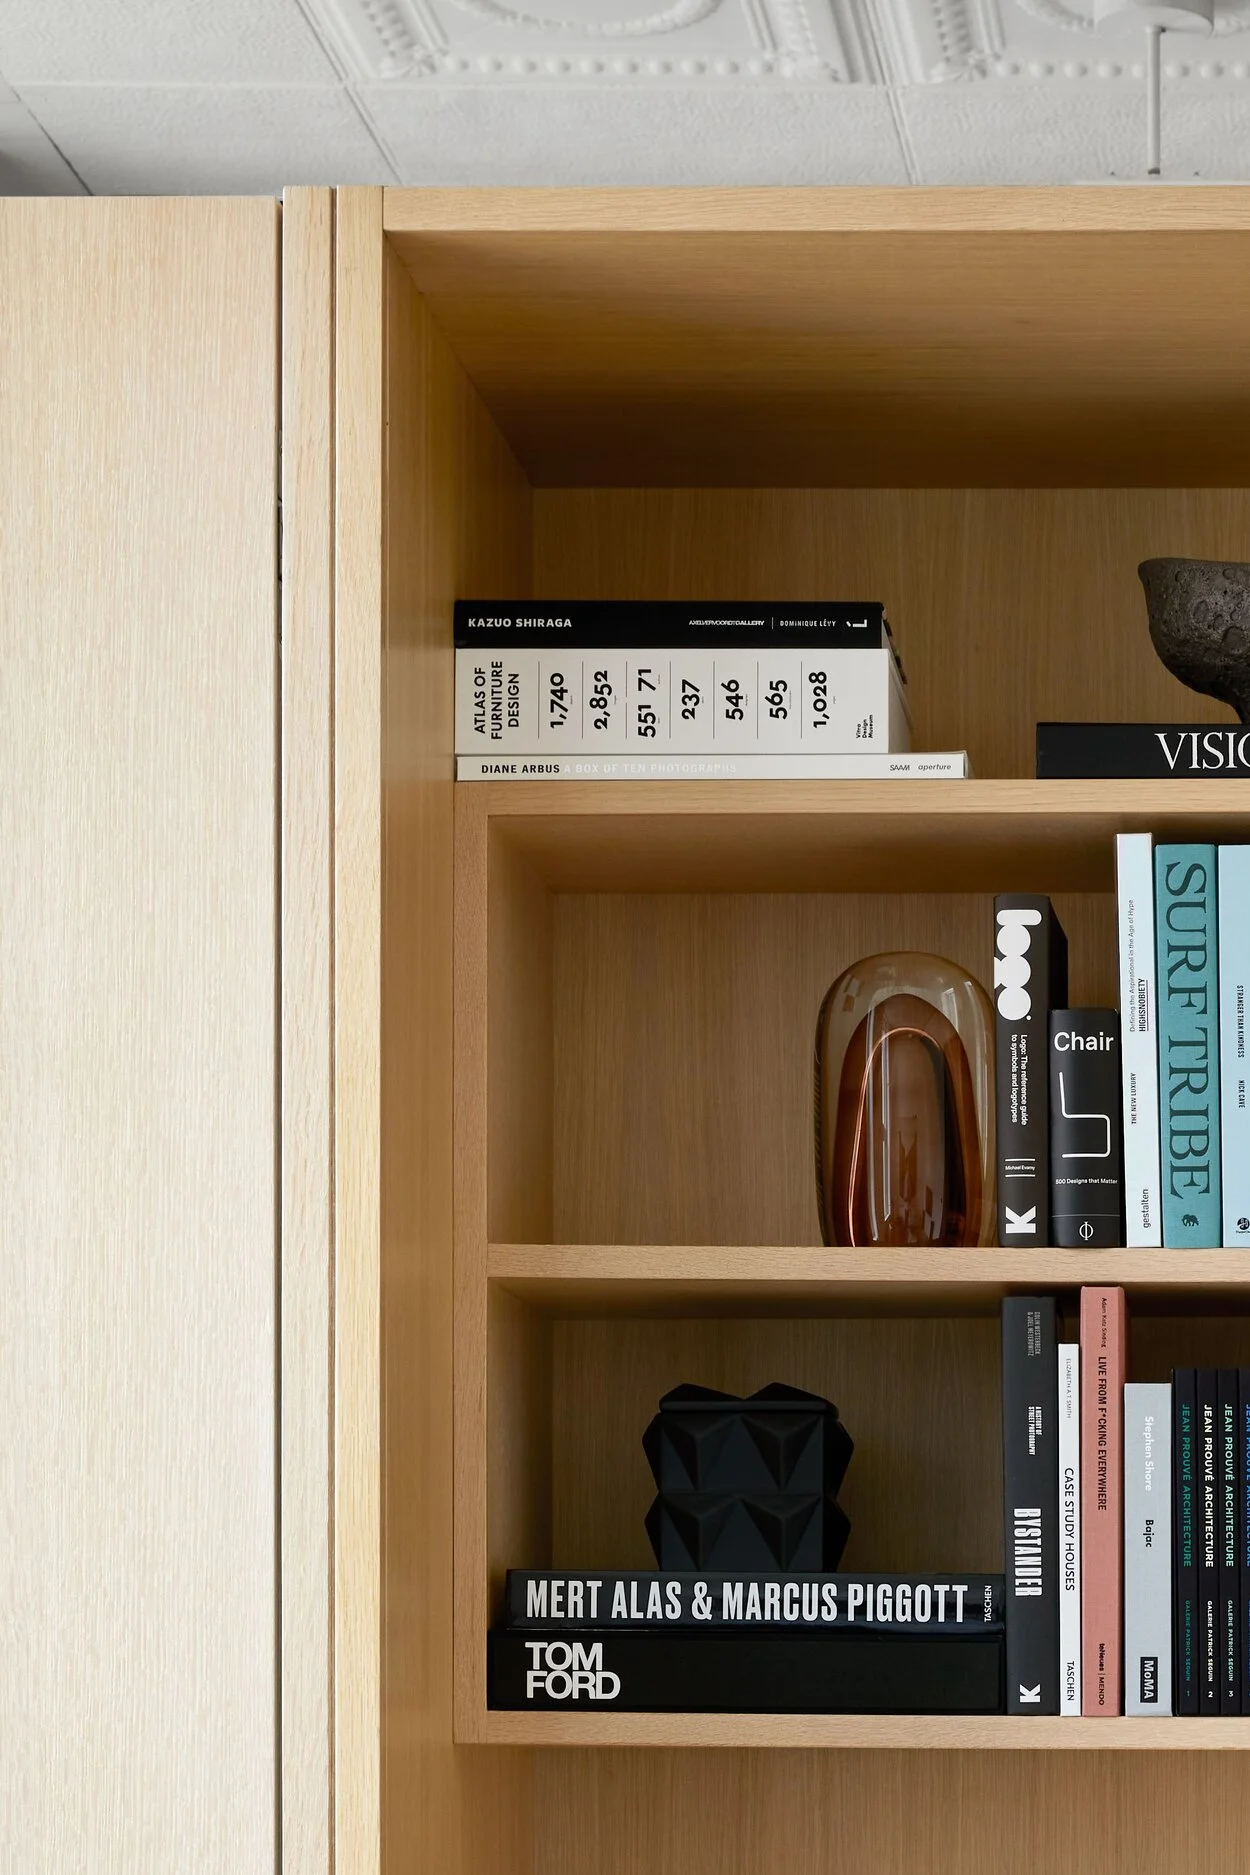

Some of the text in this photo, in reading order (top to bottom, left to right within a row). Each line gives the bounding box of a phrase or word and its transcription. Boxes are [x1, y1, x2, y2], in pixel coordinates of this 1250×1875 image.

[468, 618, 572, 628] KAZUO SHIRAGA
[638, 669, 656, 691] 71
[682, 679, 700, 719] 237
[765, 680, 787, 719] 565
[473, 667, 486, 735] ATLAS OF
[490, 661, 503, 740] FURNITURE
[507, 673, 520, 728] DESIGN
[550, 673, 568, 728] 1,740
[590, 671, 612, 729] 2,852
[721, 680, 743, 720] 546
[809, 672, 829, 728] 1,028
[638, 705, 656, 737] 551
[481, 764, 560, 774] DIANE ARBUS
[917, 763, 952, 772] aperture
[1137, 978, 1146, 1033] HIGHSNOBIETY
[1019, 1034, 1028, 1054] Logo:
[1054, 1032, 1113, 1051] Chair
[1165, 862, 1211, 1200] SURF TRIBE
[1020, 1055, 1029, 1070] The
[1237, 1079, 1246, 1109] NICK CAVE
[1006, 1206, 1036, 1233] K
[1140, 1188, 1152, 1229] gestalten
[1098, 1356, 1107, 1377] LIVE
[1098, 1378, 1107, 1405] FROM
[1142, 1416, 1155, 1492] Stephen Shore
[1098, 1449, 1107, 1511] EVERYWHERE
[1203, 1404, 1215, 1568] JEAN PROUVÉ ARCHITECTURE
[1224, 1403, 1235, 1567] JEAN PROUVÉ ARCHITECTURE
[1064, 1467, 1075, 1591] CASE STUDY HOUSES
[1142, 1519, 1155, 1548] Bajac
[1014, 1509, 1042, 1596] BYSTANDER
[527, 1580, 968, 1622] MERT ALAS & MARCUS PIGGOTT
[983, 1585, 992, 1623] TASCHEN
[525, 1641, 604, 1670] TOM
[526, 1671, 622, 1699] FORD
[1020, 1684, 1040, 1702] K
[1066, 1660, 1075, 1701] TASCHEN
[1098, 1676, 1106, 1706] MENDO
[1143, 1660, 1155, 1699] MoMA
